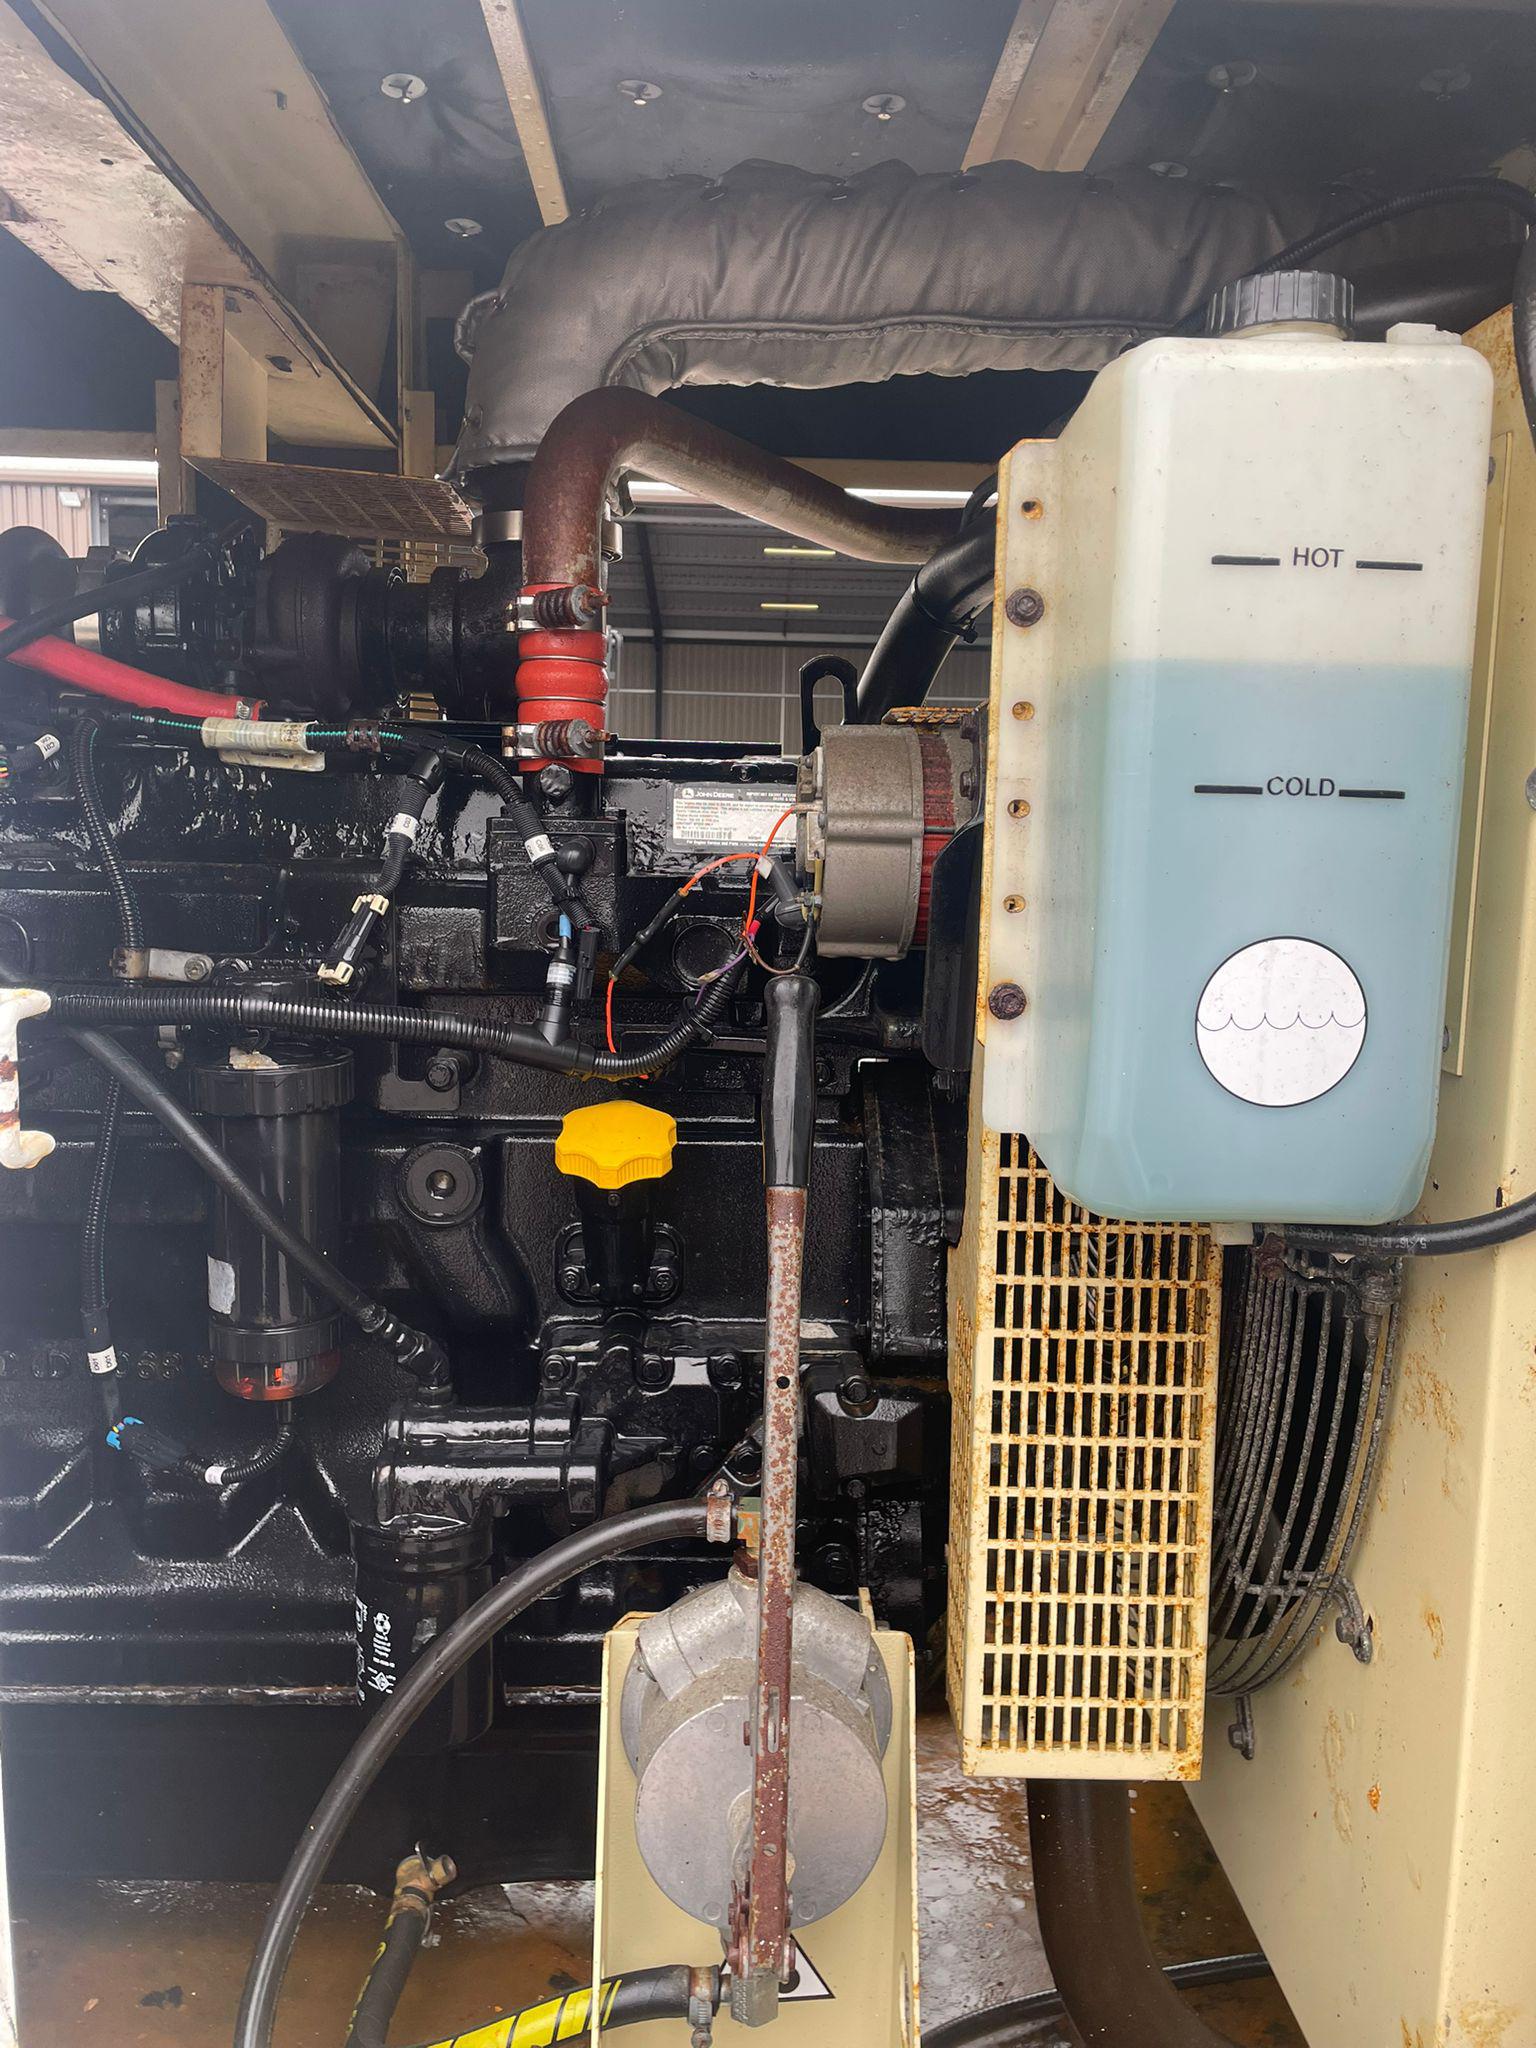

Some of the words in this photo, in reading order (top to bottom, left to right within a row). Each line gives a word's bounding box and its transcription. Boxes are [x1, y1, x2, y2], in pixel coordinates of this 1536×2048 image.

[1293, 546, 1345, 568] HOT
[712, 791, 735, 799] DEERE
[1266, 775, 1336, 797] COLD
